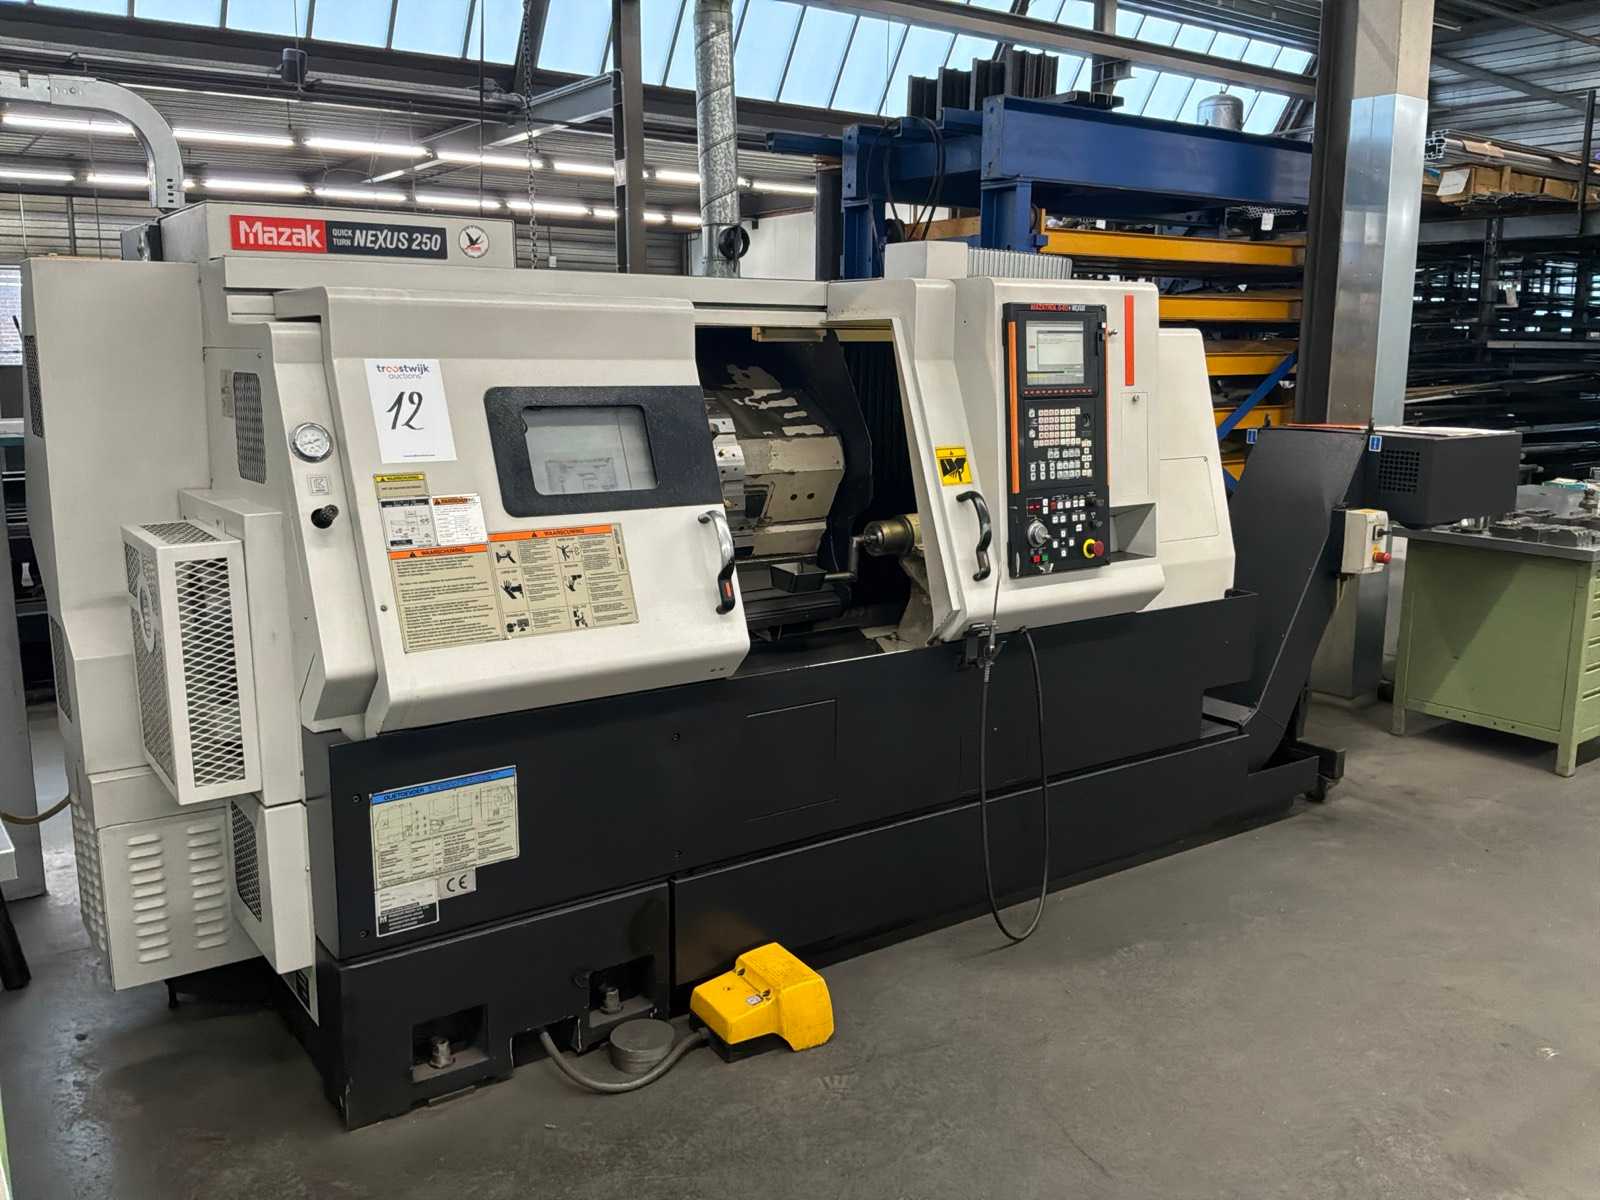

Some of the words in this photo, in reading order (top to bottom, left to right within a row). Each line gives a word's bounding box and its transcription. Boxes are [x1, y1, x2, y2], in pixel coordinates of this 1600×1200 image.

[239, 220, 322, 248] Mazak
[332, 228, 352, 237] QUICK
[354, 229, 408, 250] NEXUS
[411, 233, 441, 251] 250
[333, 238, 351, 246] TURN
[376, 363, 430, 375] troostwijk
[386, 391, 425, 430] 12
[446, 875, 468, 892] CE
